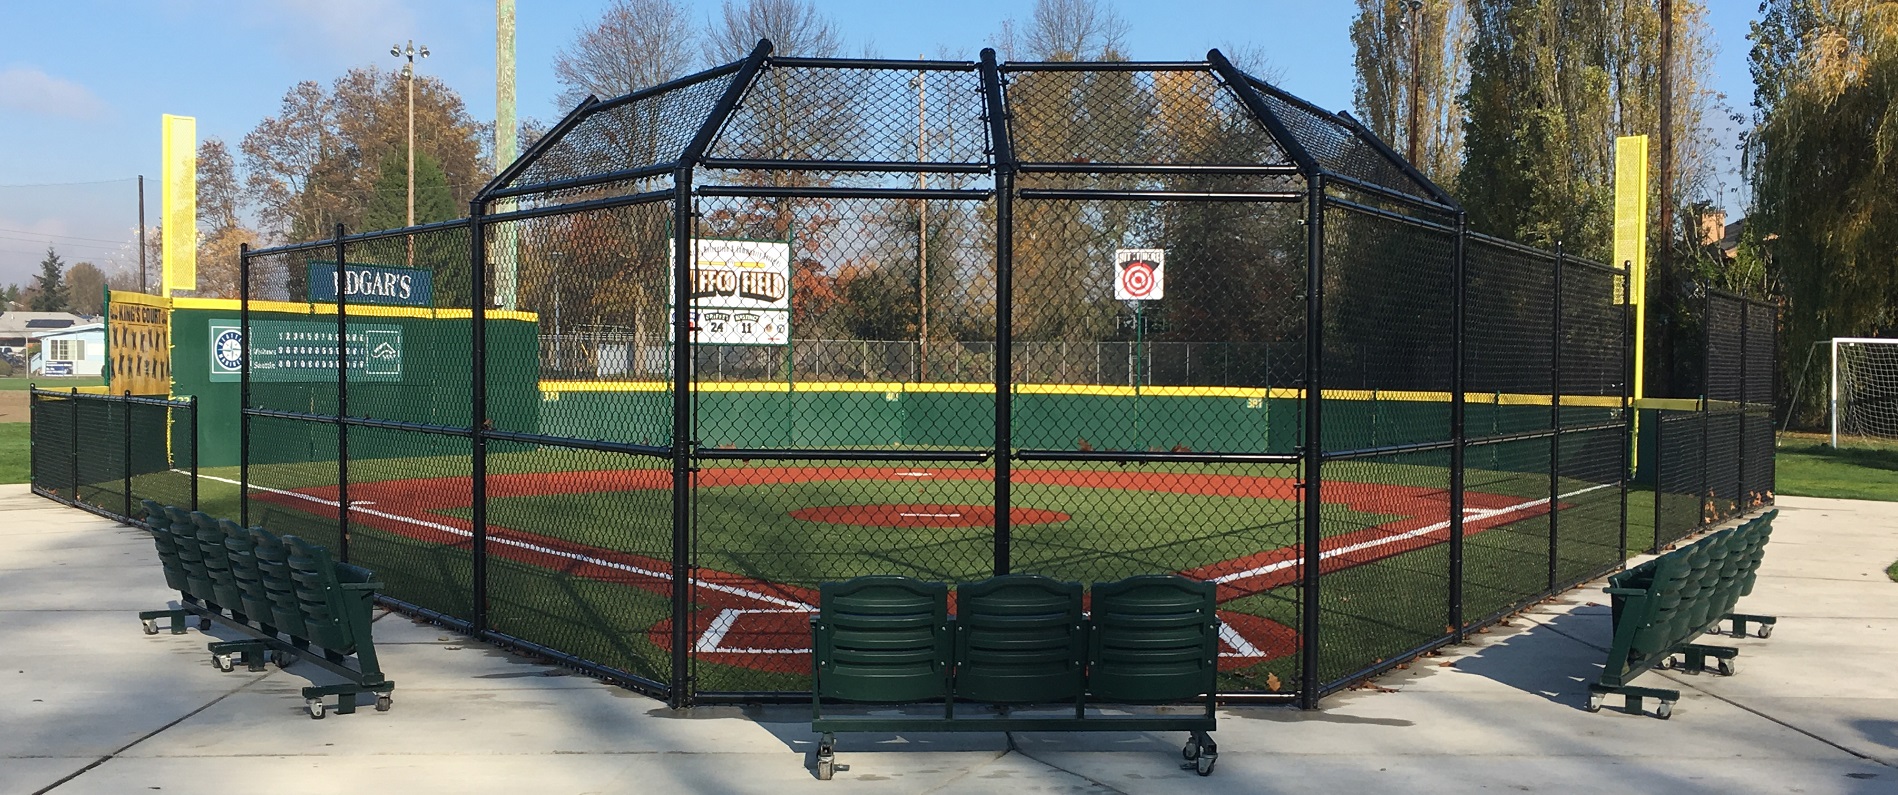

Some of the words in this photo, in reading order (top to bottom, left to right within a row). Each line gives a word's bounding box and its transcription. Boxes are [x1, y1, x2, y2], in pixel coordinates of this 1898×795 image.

[740, 271, 785, 302] FIELD
[119, 305, 140, 323] KING'S
[142, 307, 161, 324] COURT
[711, 322, 724, 333] 24
[741, 322, 752, 333] 11
